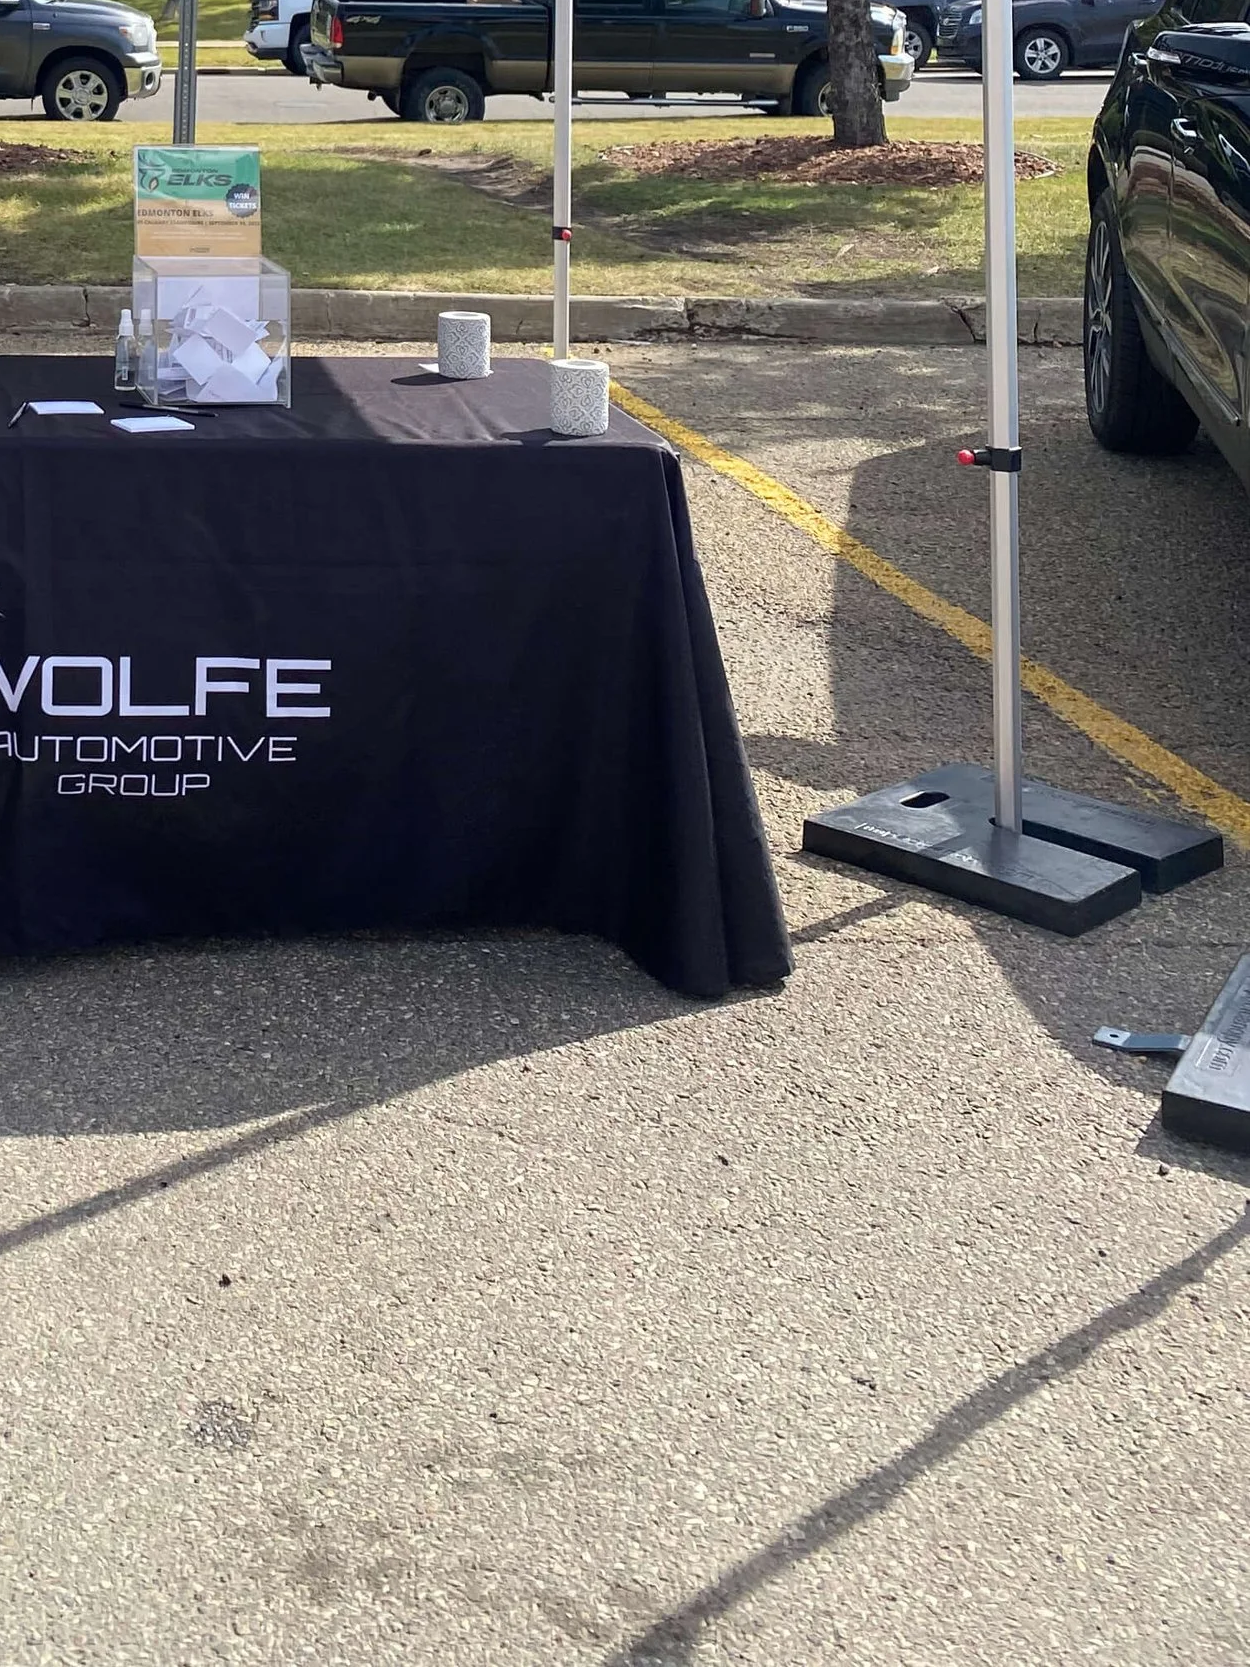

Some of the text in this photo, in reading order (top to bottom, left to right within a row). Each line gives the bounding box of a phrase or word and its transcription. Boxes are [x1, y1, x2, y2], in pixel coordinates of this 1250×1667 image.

[167, 174, 232, 187] ELKS
[138, 209, 190, 217] EDMONTON
[57, 772, 210, 797] GROUP
